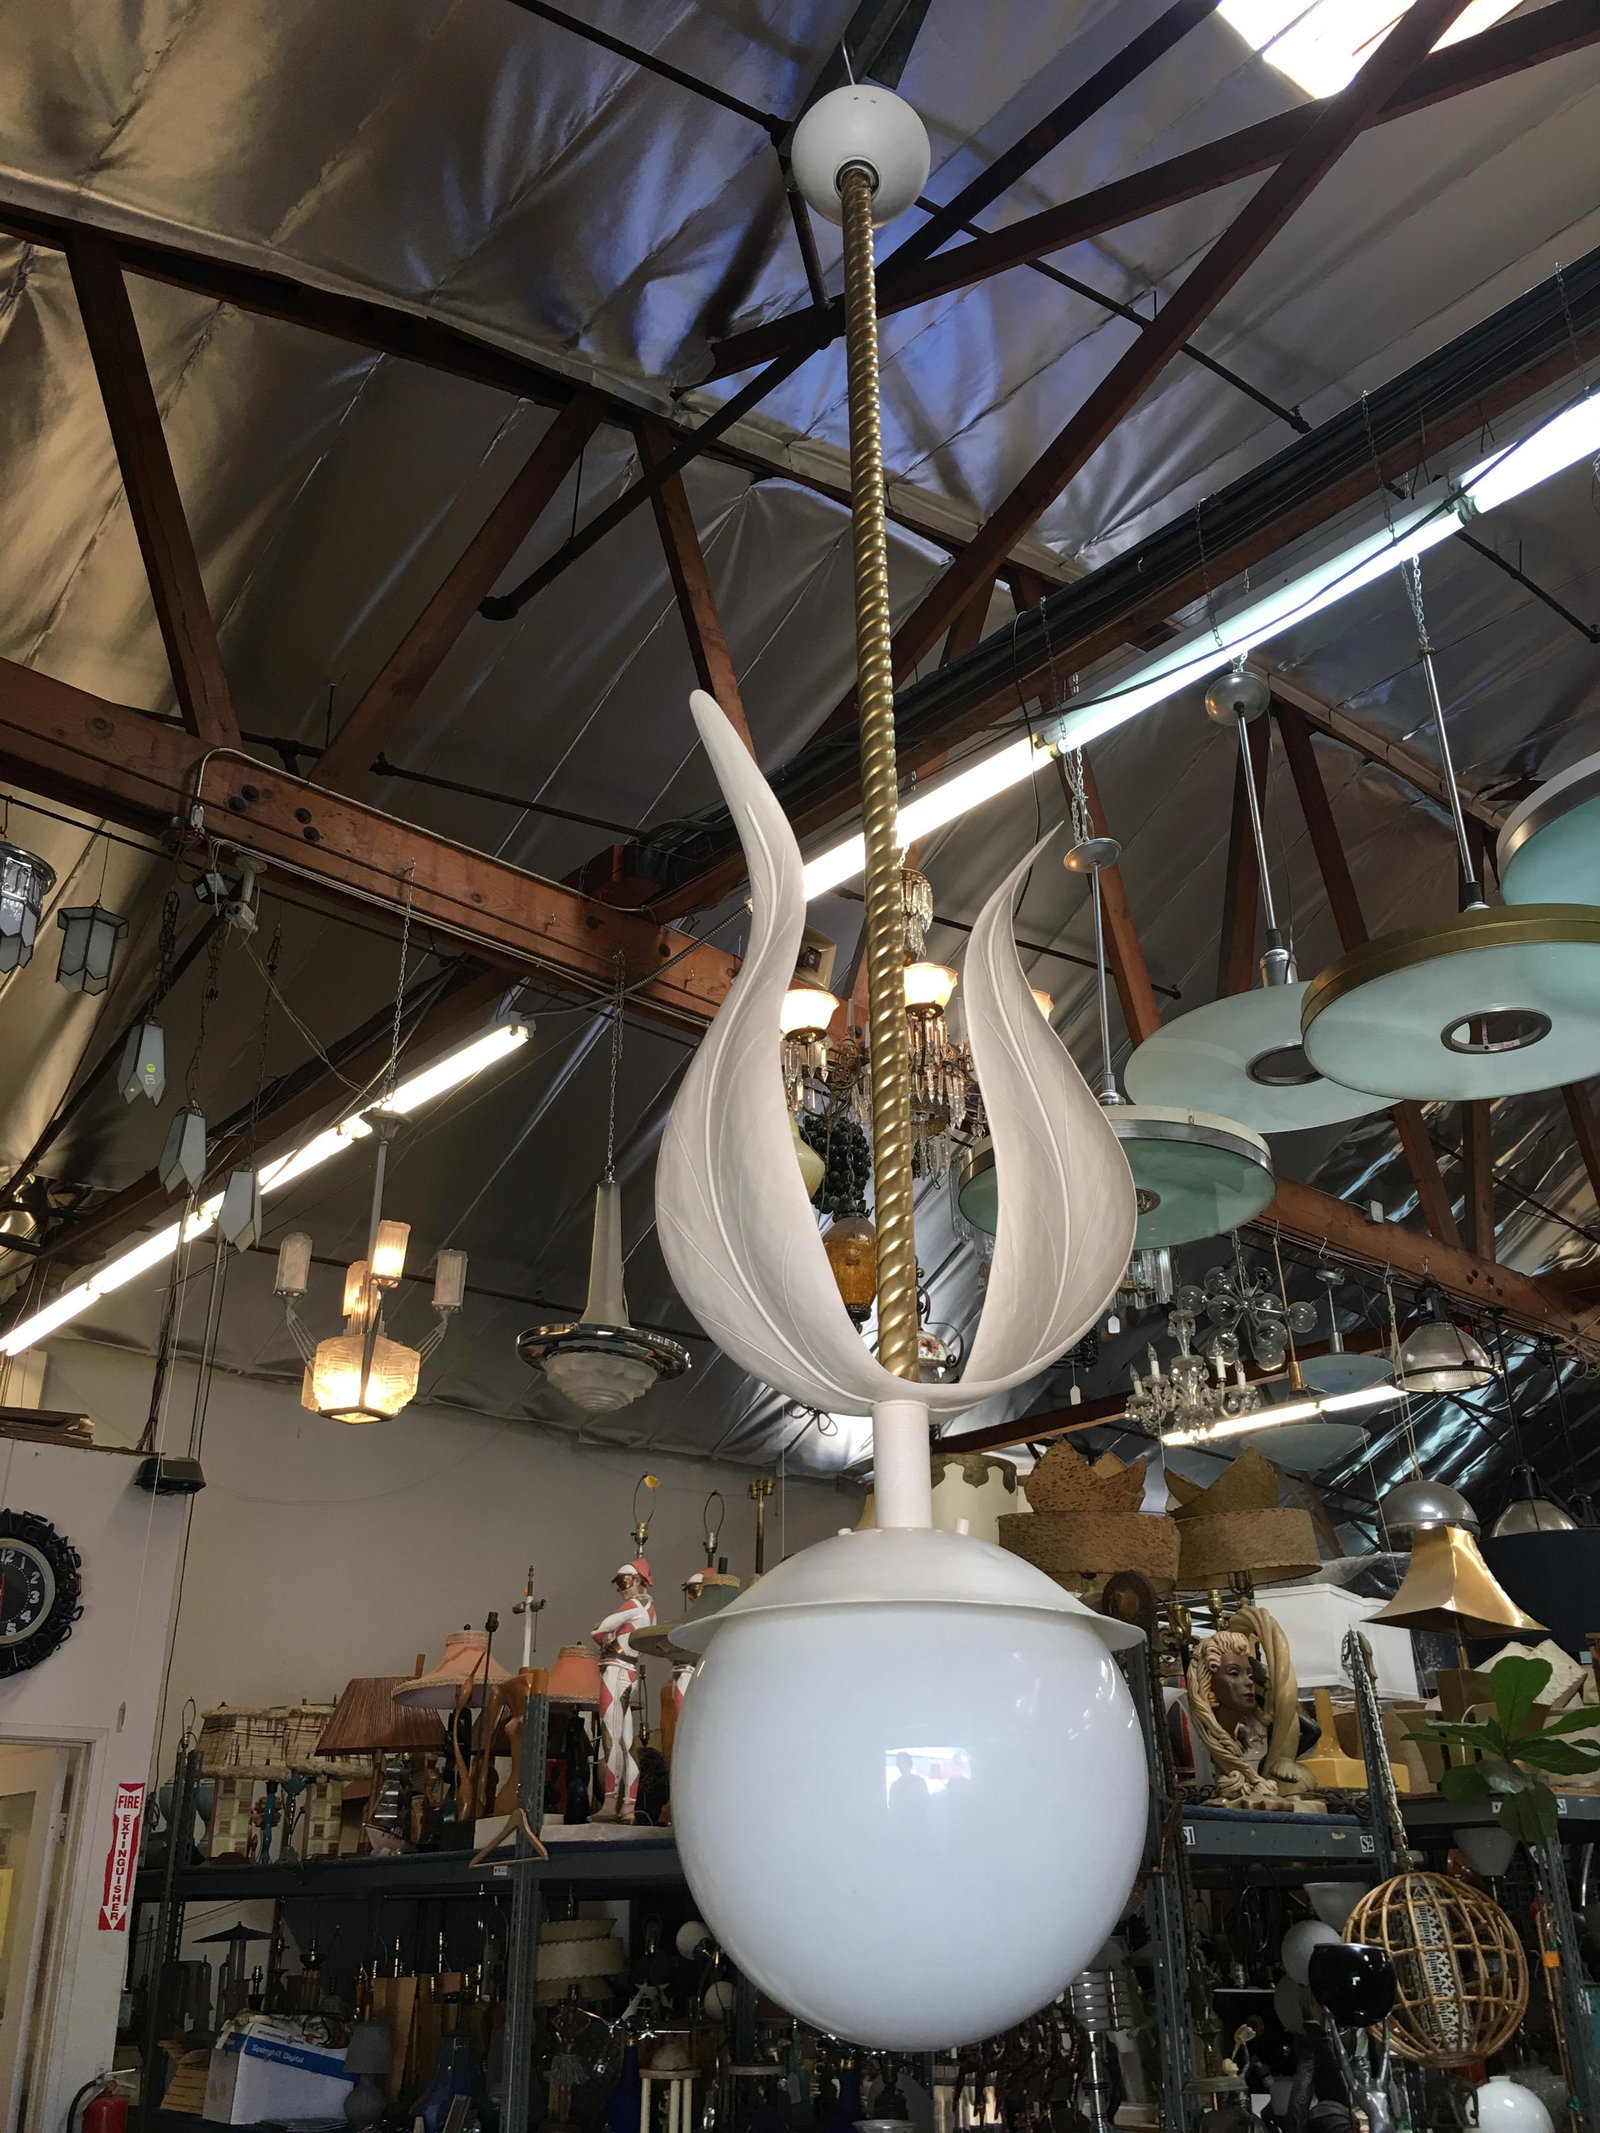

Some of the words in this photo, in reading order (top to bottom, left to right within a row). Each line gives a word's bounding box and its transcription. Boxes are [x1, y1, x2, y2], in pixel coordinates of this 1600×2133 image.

[1, 1550, 15, 1563] 12
[21, 1556, 26, 1569] 1
[30, 1572, 40, 1584] 2
[29, 1590, 40, 1604] 3
[20, 1610, 32, 1623] 4
[5, 1623, 17, 1636] 5
[118, 1795, 140, 1809] FIRE
[1361, 1836, 1373, 1851] S2
[109, 1814, 132, 1921] EXTINGUISHER
[252, 2043, 282, 2059] Springhill
[283, 2052, 305, 2063] Digital
